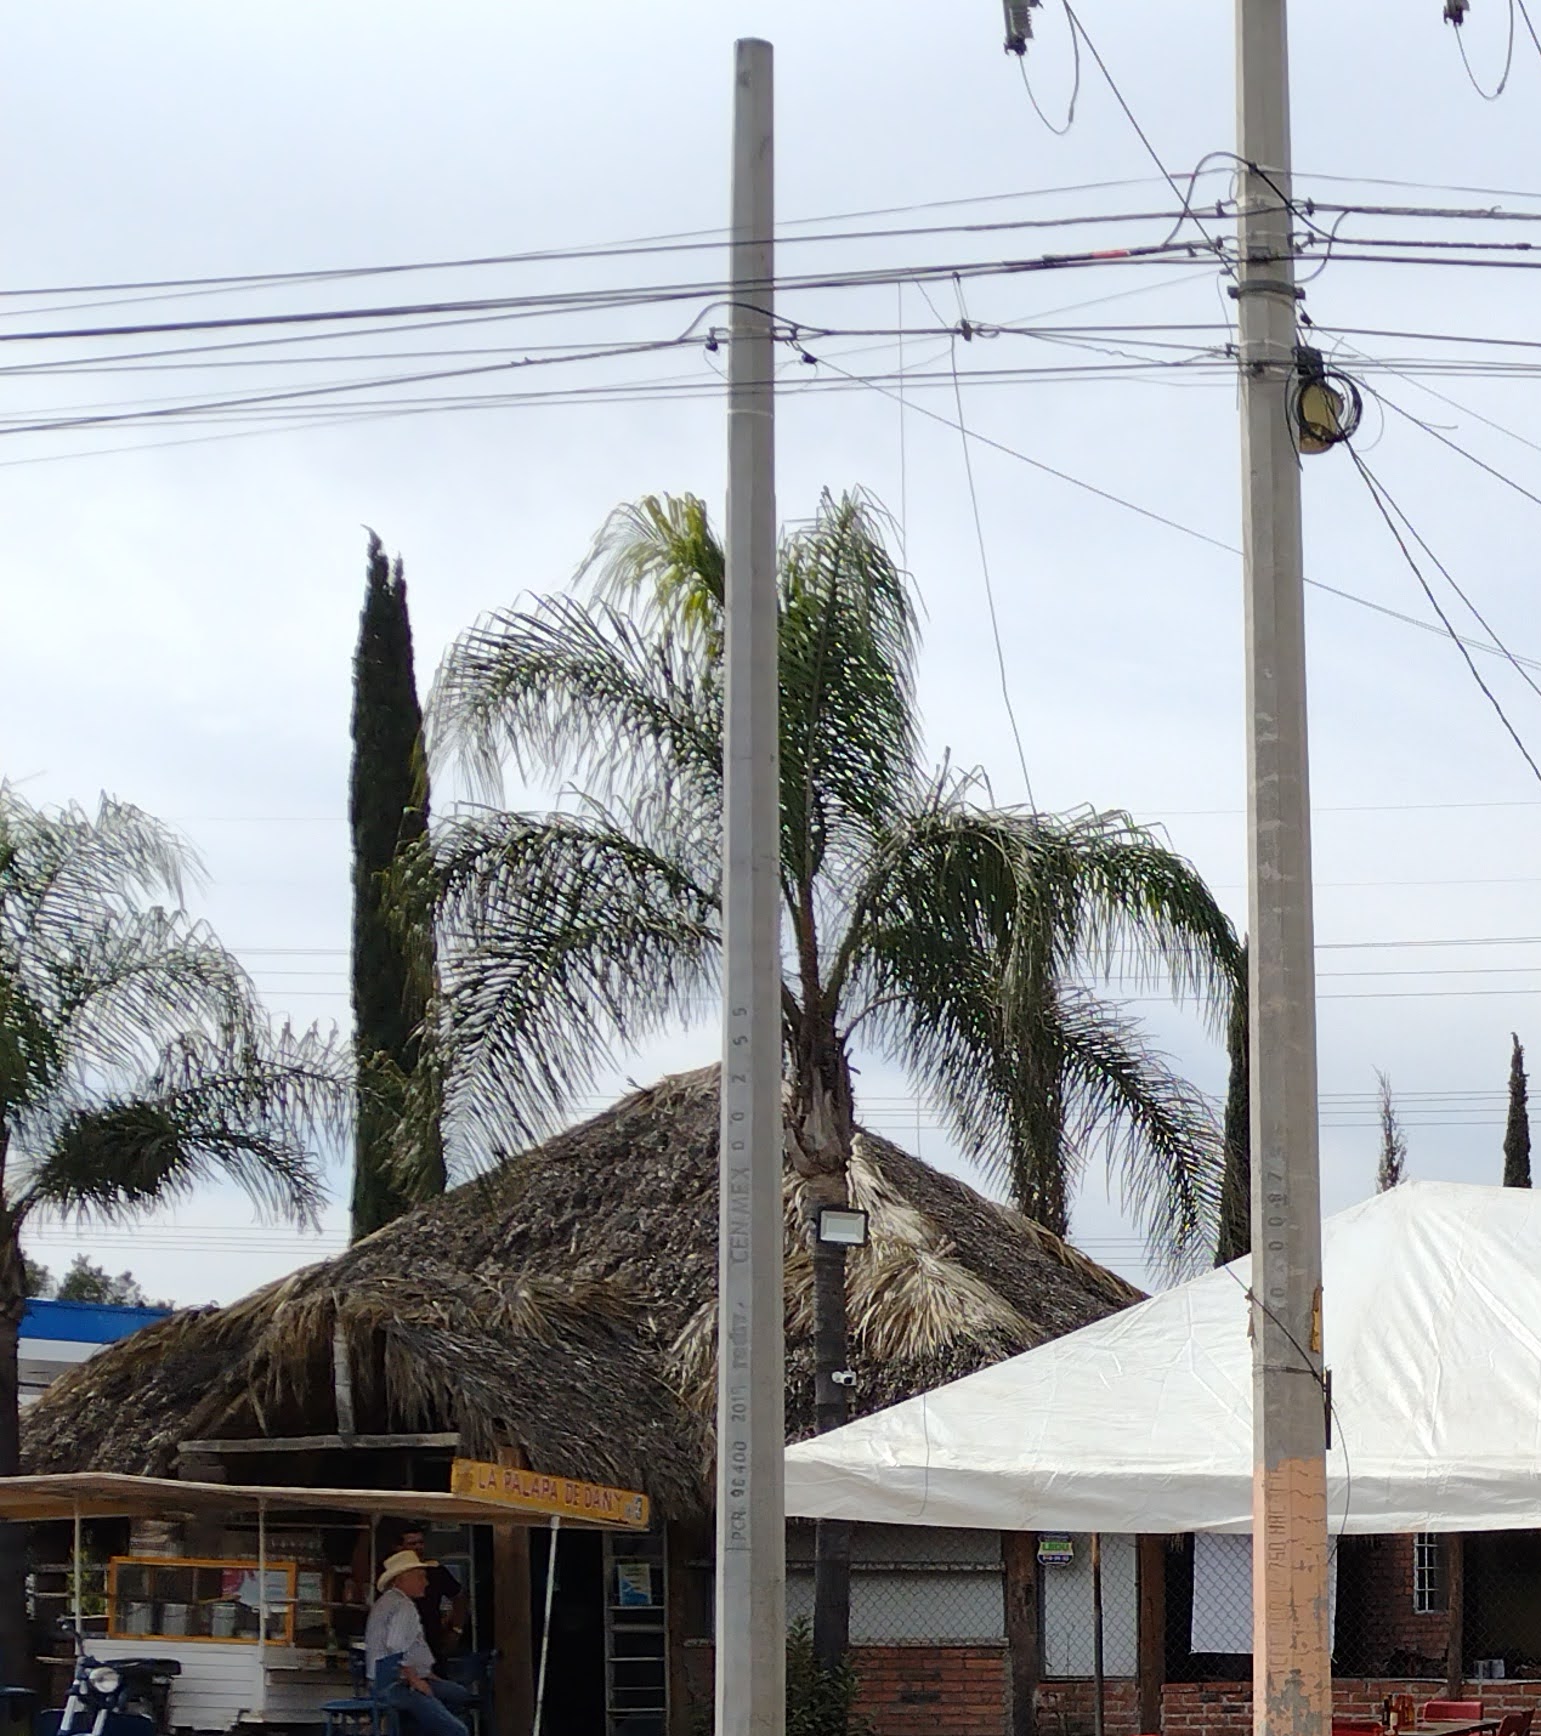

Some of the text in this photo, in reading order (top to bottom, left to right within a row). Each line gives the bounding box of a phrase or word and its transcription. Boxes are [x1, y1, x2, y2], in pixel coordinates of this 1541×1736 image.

[478, 1467, 497, 1490] LA
[504, 1470, 558, 1501] PALAPA
[564, 1481, 579, 1507] DE
[584, 1486, 623, 1513] DANY
